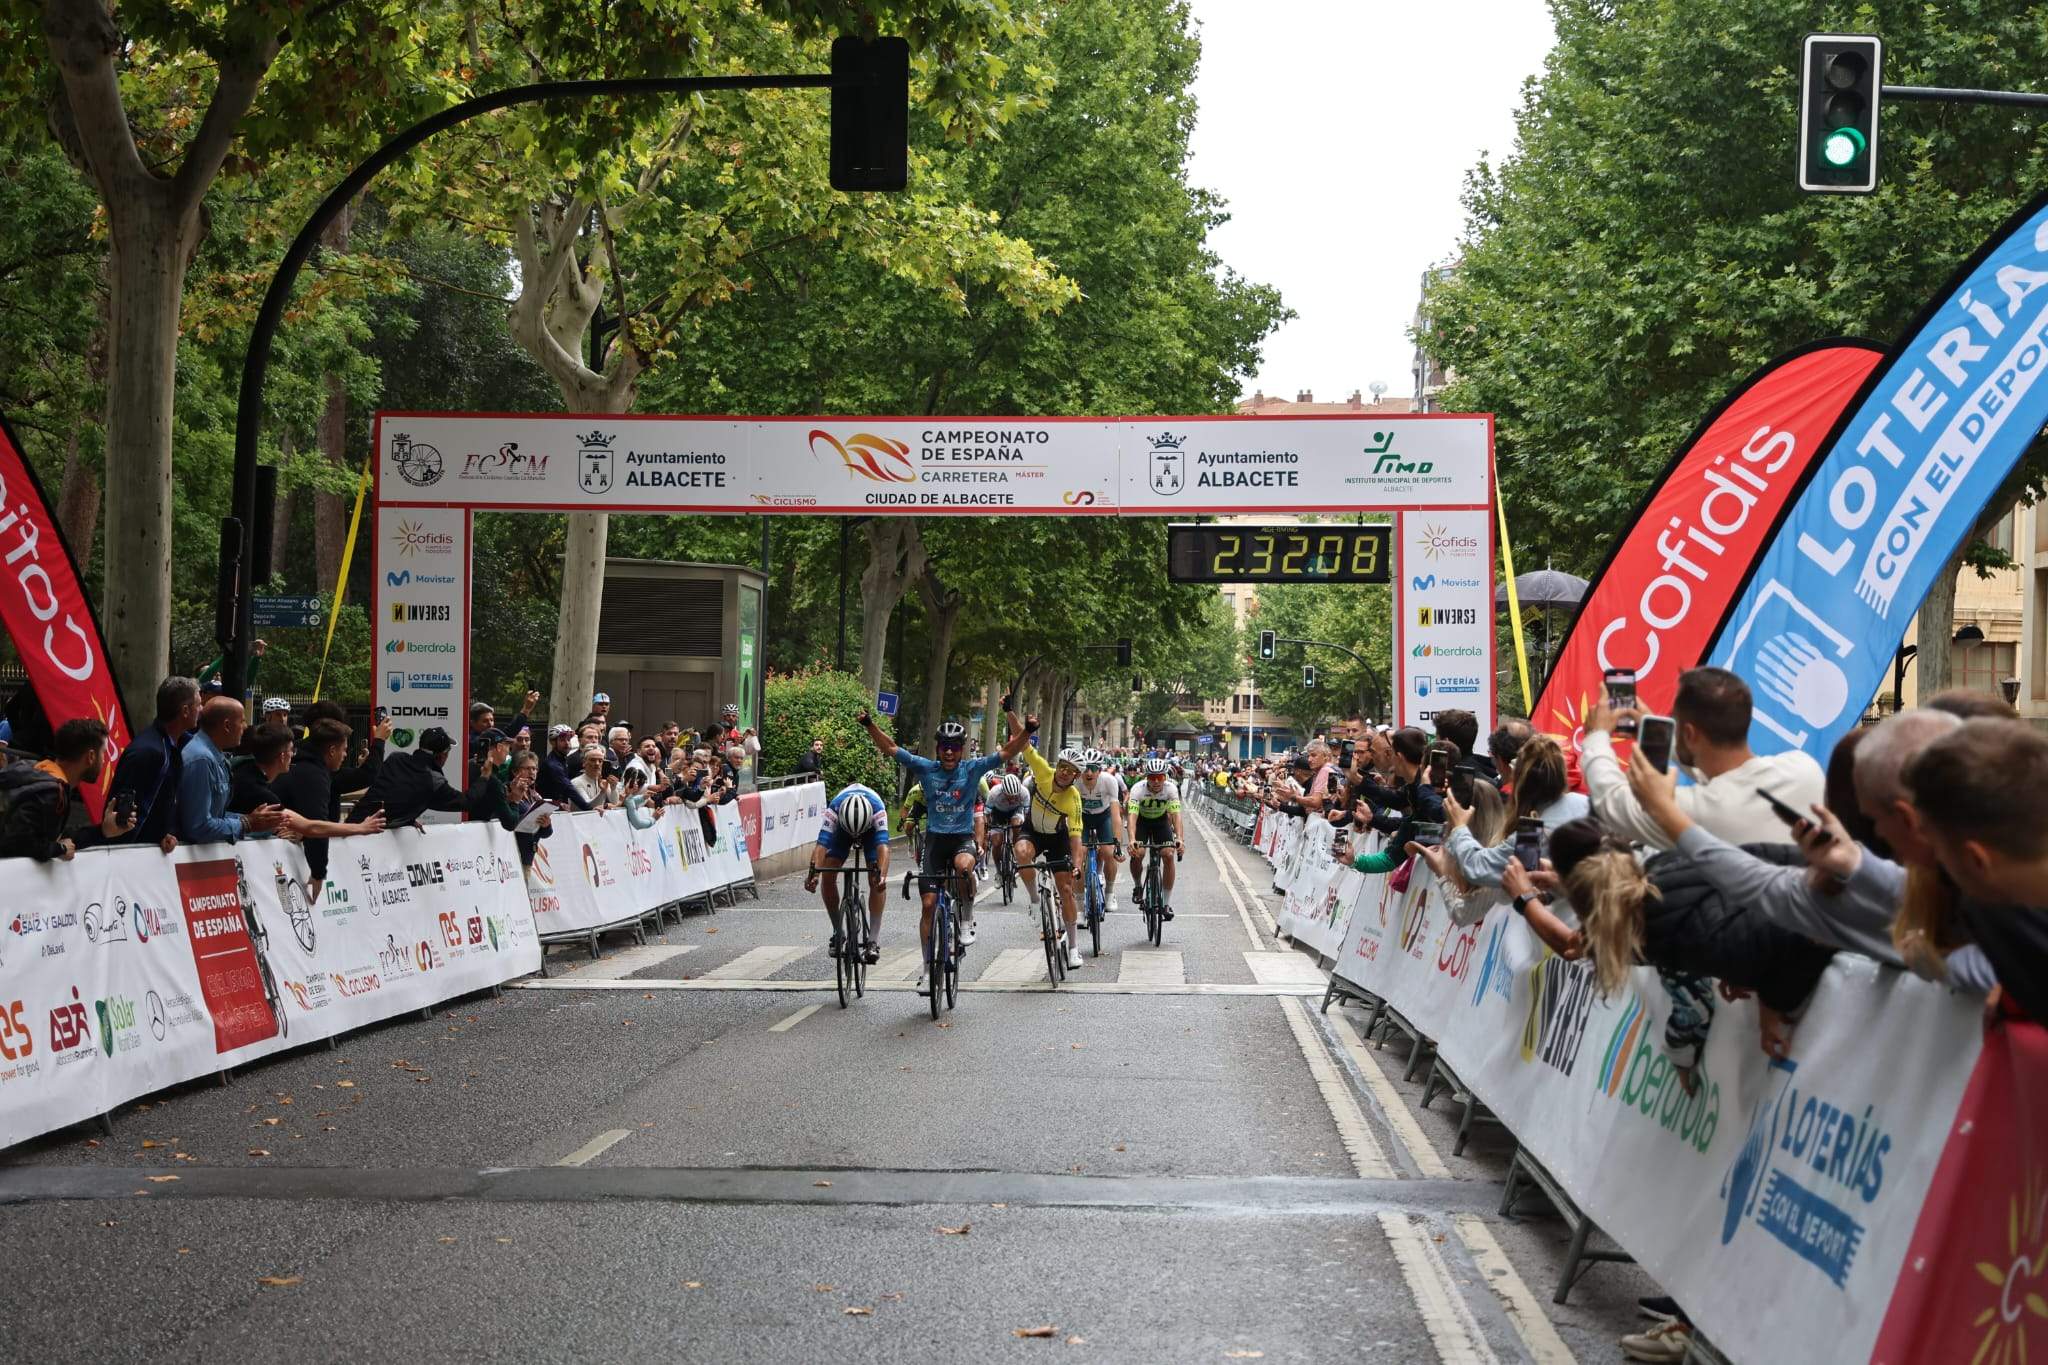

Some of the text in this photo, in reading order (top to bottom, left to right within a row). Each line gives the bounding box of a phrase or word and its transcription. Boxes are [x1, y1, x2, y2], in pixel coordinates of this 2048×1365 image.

[1798, 219, 2048, 576] LOTERÍA
[921, 430, 1049, 444] CAMPEONATO
[626, 451, 726, 466] Ayuntamiento
[921, 445, 1024, 461] DE ESPAÑA
[1197, 450, 1299, 465] Ayuntamiento
[625, 471, 726, 487] ALBACETE
[921, 471, 1009, 483] CARRETERA
[1197, 471, 1299, 487] ALBACETE
[773, 498, 817, 506] CICLISMO
[865, 493, 1015, 505] CIUDAD DE ALBACETE
[1875, 500, 1930, 581] CON
[1929, 452, 1964, 491] EL
[407, 533, 454, 544] Cofidis
[1432, 536, 1478, 548] Cofidis
[1597, 425, 1797, 681] Cofidis
[416, 575, 456, 584] Movistar
[1441, 578, 1481, 587] Movistar
[408, 605, 450, 621] INVERSE
[1434, 608, 1476, 625] INVERSE
[407, 642, 456, 653] Iberdrola
[1434, 646, 1482, 657] Iberdrola
[408, 673, 454, 681] LOTERÍAS
[1435, 676, 1481, 685] LOTERÍAS
[392, 706, 449, 717] DOMUS
[407, 861, 444, 888] DOMUS
[188, 892, 237, 913] CAMPEONATO
[193, 921, 205, 942] DE
[207, 909, 243, 937] ESPAÑA
[1781, 1088, 1892, 1203] LOTERÍAS
